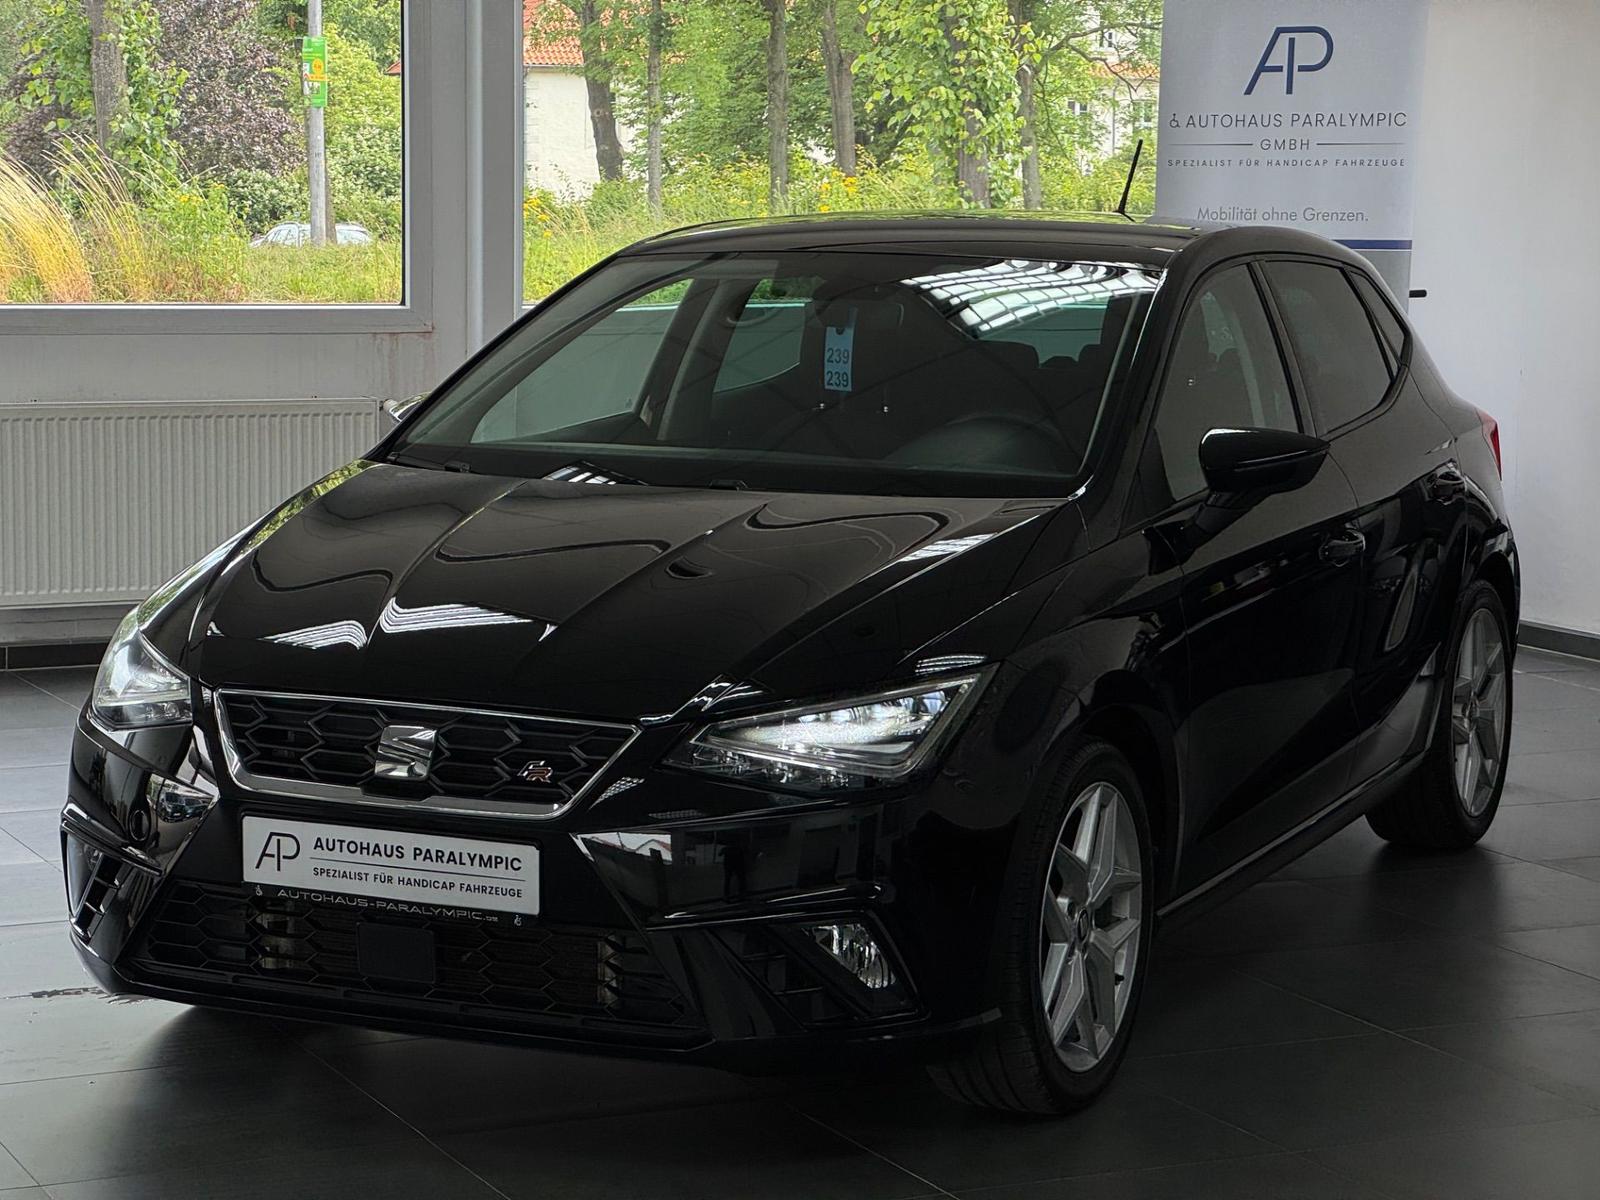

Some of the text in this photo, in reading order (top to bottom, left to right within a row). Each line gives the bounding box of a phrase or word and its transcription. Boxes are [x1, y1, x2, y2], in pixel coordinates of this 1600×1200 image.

[1185, 112, 1407, 129] AUTOHAUS PARALYMPIC
[1260, 138, 1311, 151] GMBH
[1167, 158, 1406, 167] SPEZIALIST FÜR HANDICAP FAHRZEUGE
[1197, 207, 1369, 222] Mobilität ohne Grenzen.
[826, 347, 850, 365] 239
[826, 370, 849, 388] 239
[313, 836, 523, 872] AUTOHAUS PARALYMPIC
[312, 867, 523, 898] SPEZIALIST FÜR HANDICAP FAHRZEUGE
